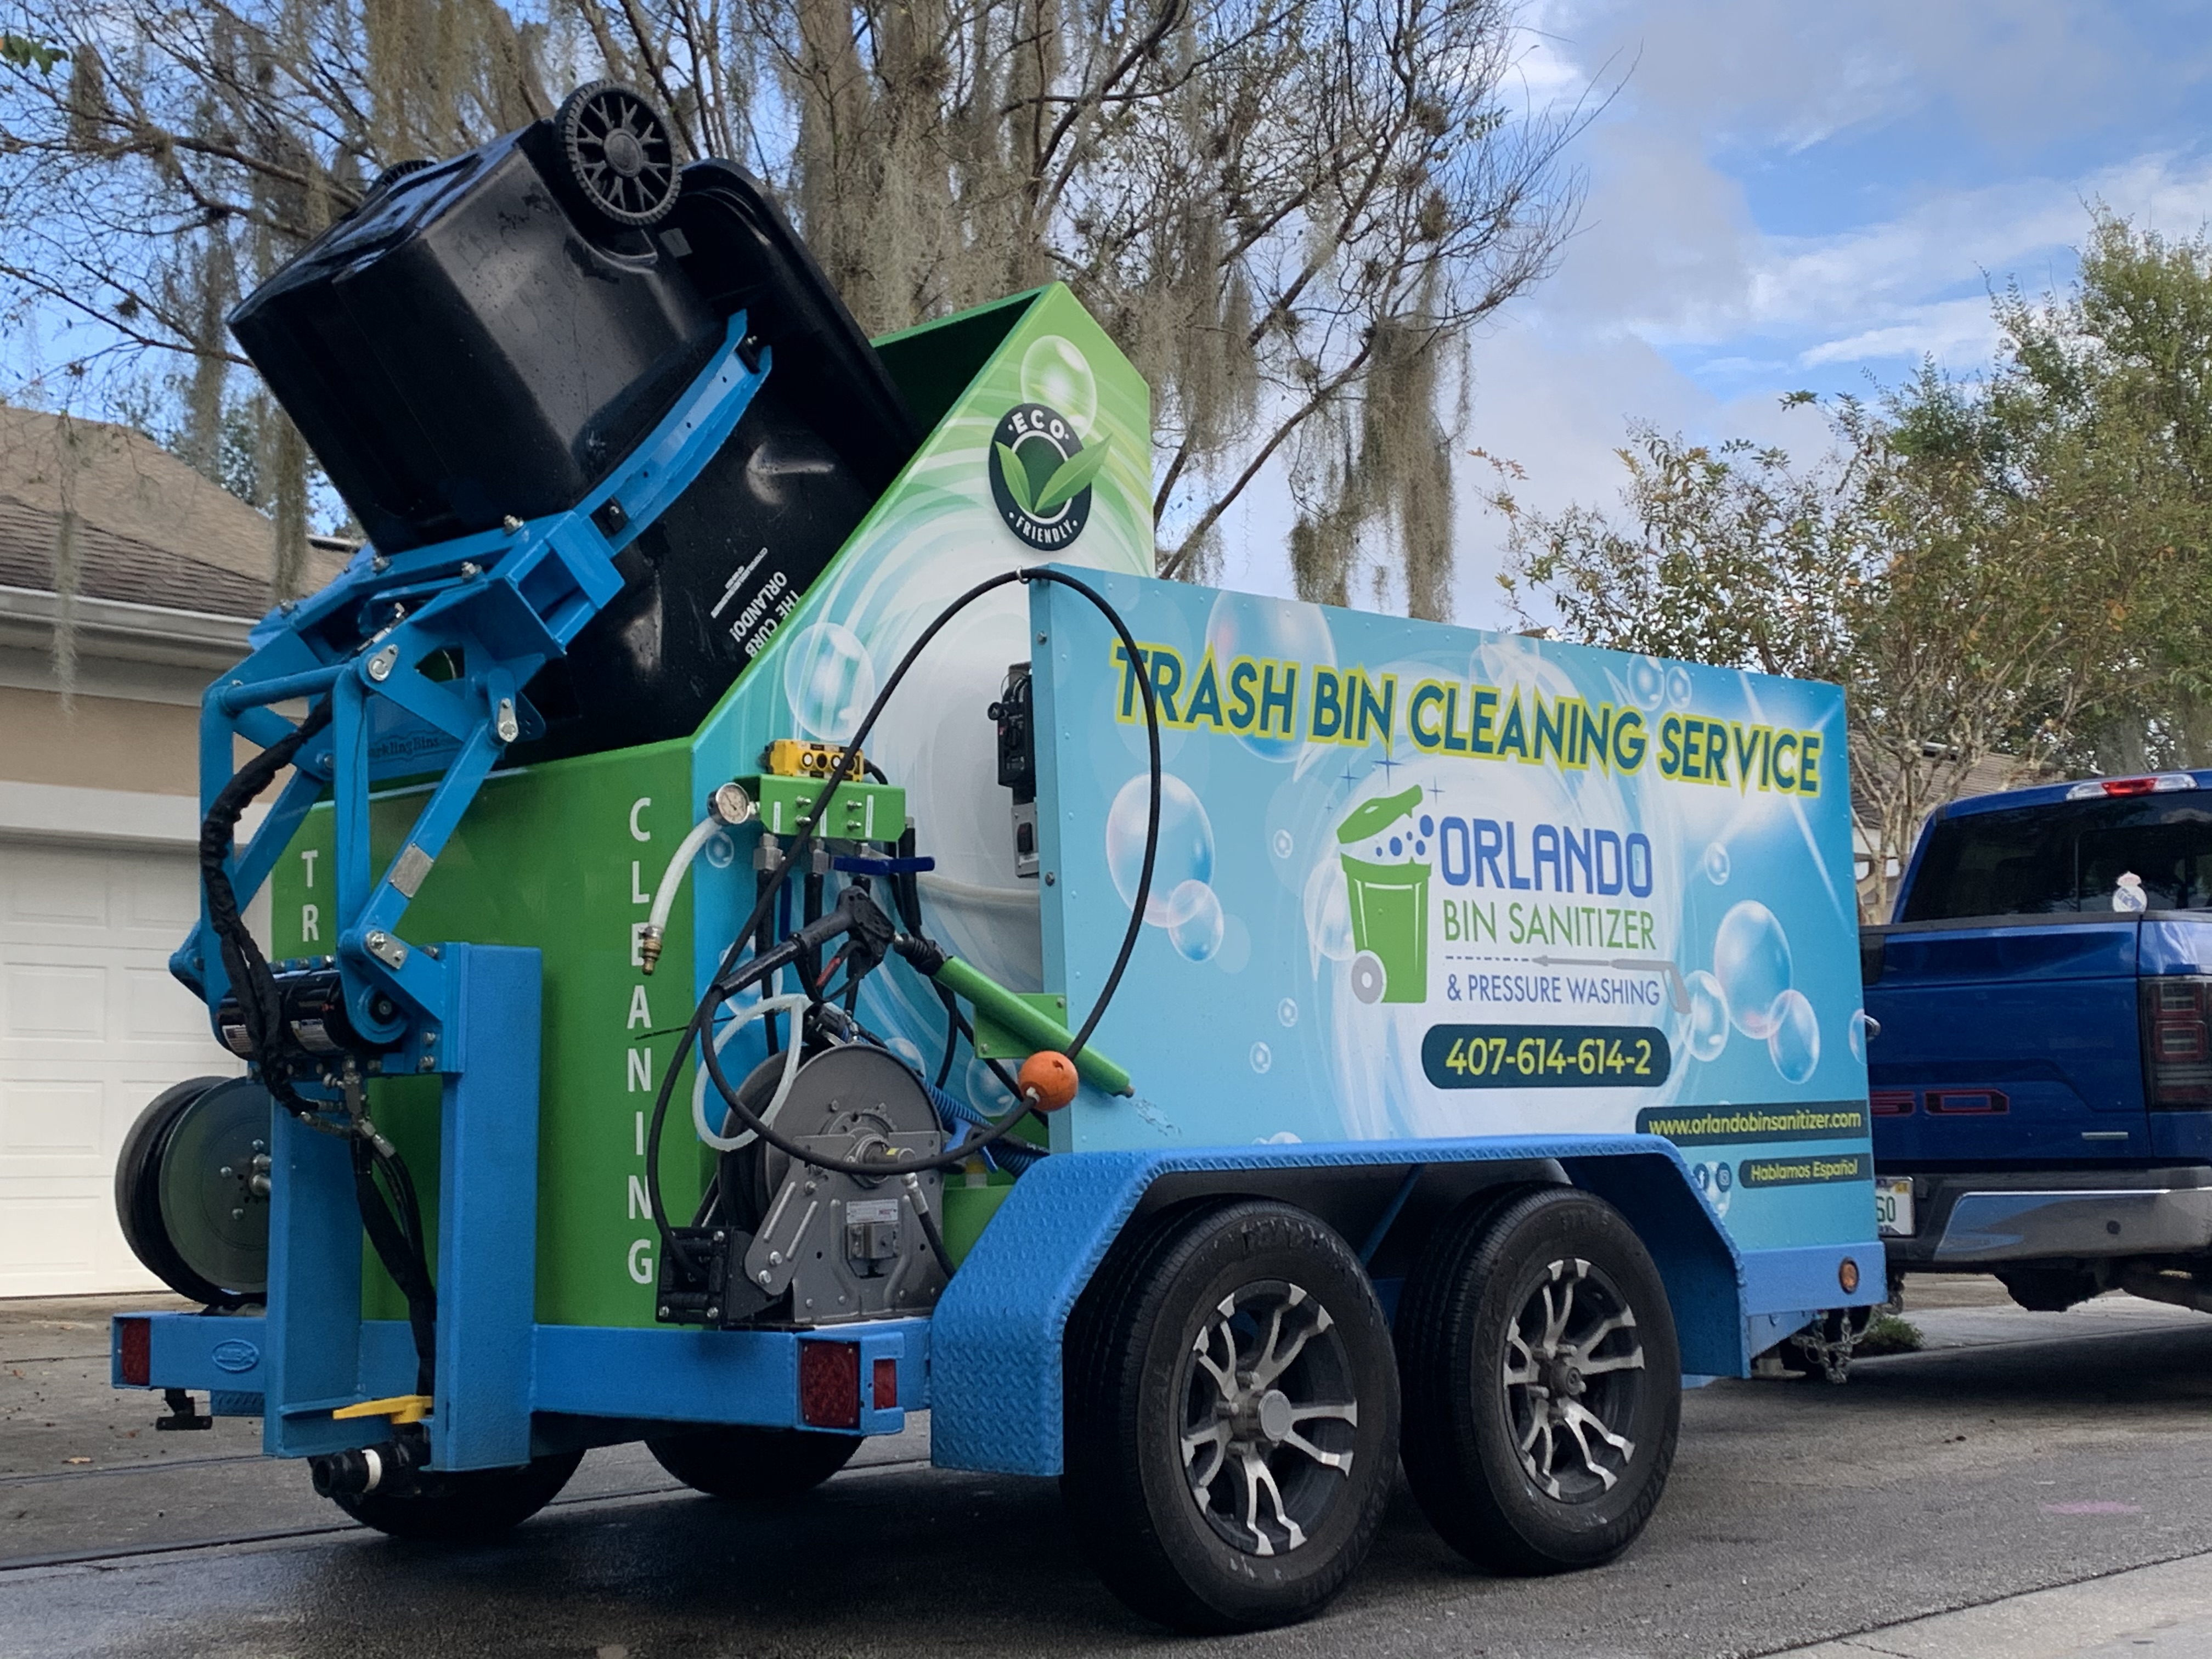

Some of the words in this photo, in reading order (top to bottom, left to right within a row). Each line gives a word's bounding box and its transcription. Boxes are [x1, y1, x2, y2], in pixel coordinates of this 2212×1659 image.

[1012, 409, 1065, 439] ECO
[1016, 515, 1073, 543] FRIENDLY
[729, 571, 788, 643] ORLANDO!
[775, 590, 801, 620] THE
[744, 618, 778, 658] CURB
[1110, 639, 1300, 741] TRASH
[1308, 663, 1398, 755] BIN
[1407, 678, 1649, 780] CLEANING
[1656, 712, 1823, 797] SERVICE
[1440, 816, 1652, 898] ORLANDO
[1443, 900, 1497, 944] BIN
[1509, 902, 1656, 950] SANITIZER
[1447, 974, 1462, 1001] &
[1468, 974, 1562, 1002] PRESSURE
[1566, 977, 1660, 1006] WASHING
[627, 797, 653, 1284] CLEANING
[1446, 1037, 1651, 1075] 407-614-614-2
[1649, 1109, 1861, 1135] www.orlandobinsanitizer.com
[1751, 1162, 1810, 1182] Hablamos
[1814, 1158, 1859, 1180] Español
